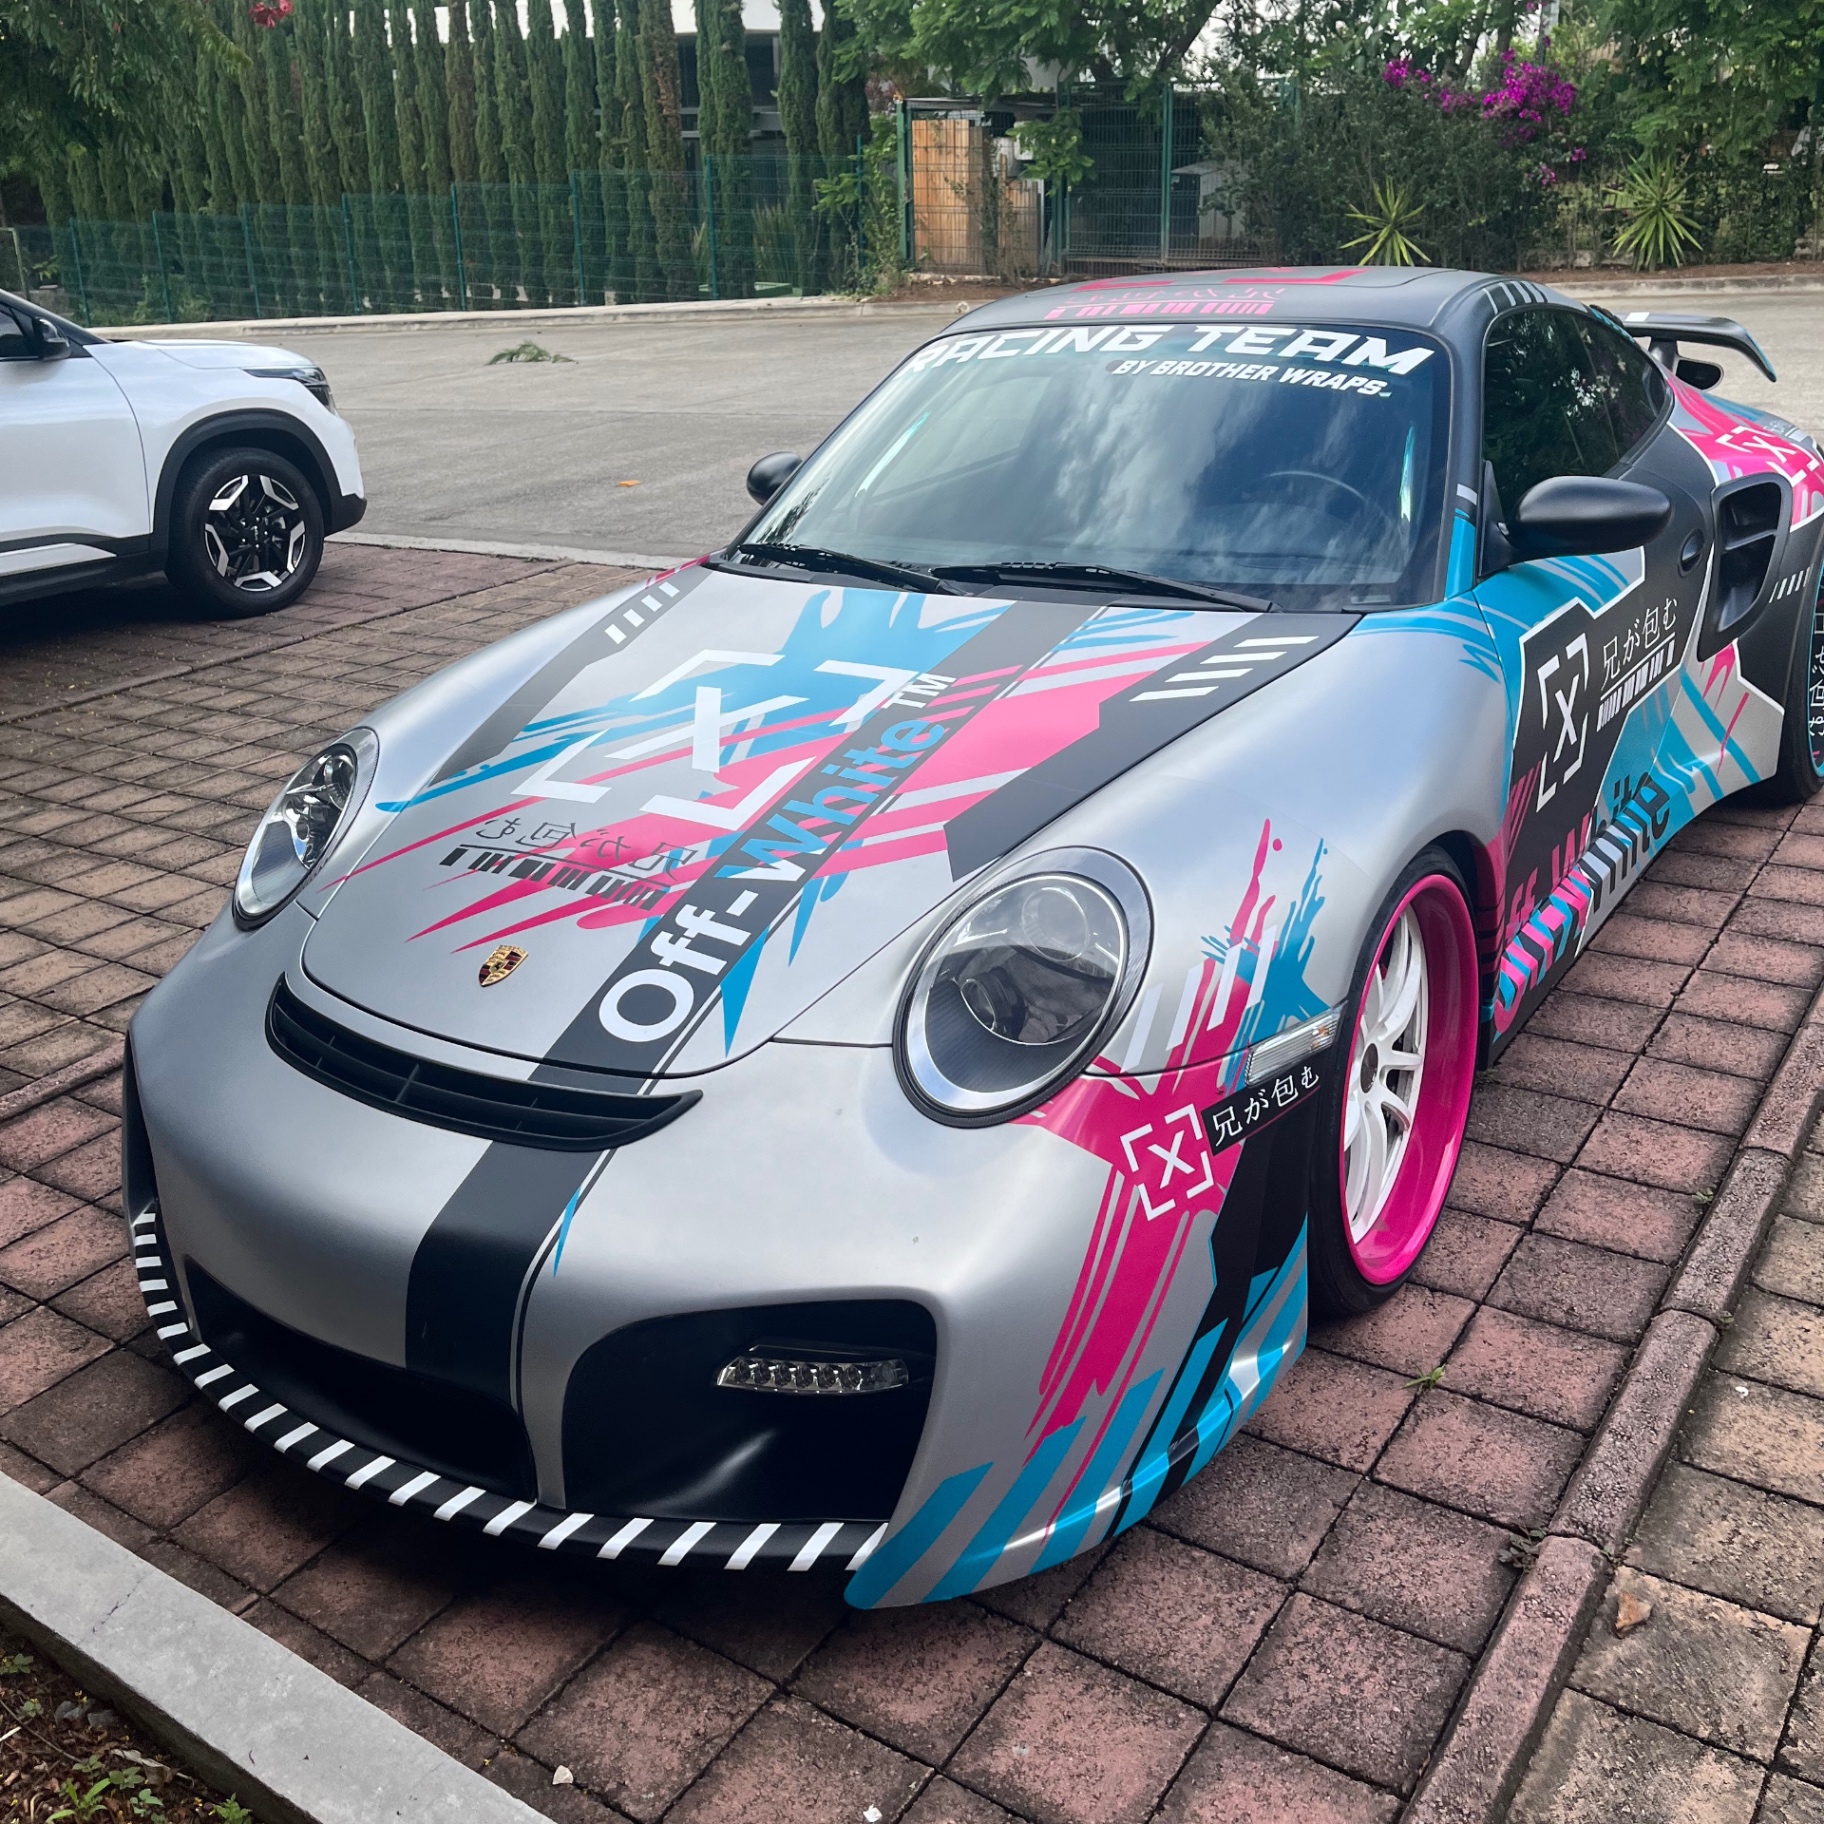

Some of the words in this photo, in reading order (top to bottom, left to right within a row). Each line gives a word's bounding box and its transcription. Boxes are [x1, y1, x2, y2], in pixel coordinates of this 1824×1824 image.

[892, 325, 1175, 381] RACING
[1187, 325, 1435, 376] TEAM
[1111, 359, 1158, 376] BY
[1150, 360, 1280, 382] BROTHER
[1600, 597, 1677, 692] 兄が包む
[1212, 1065, 1320, 1147] 兄が包む
